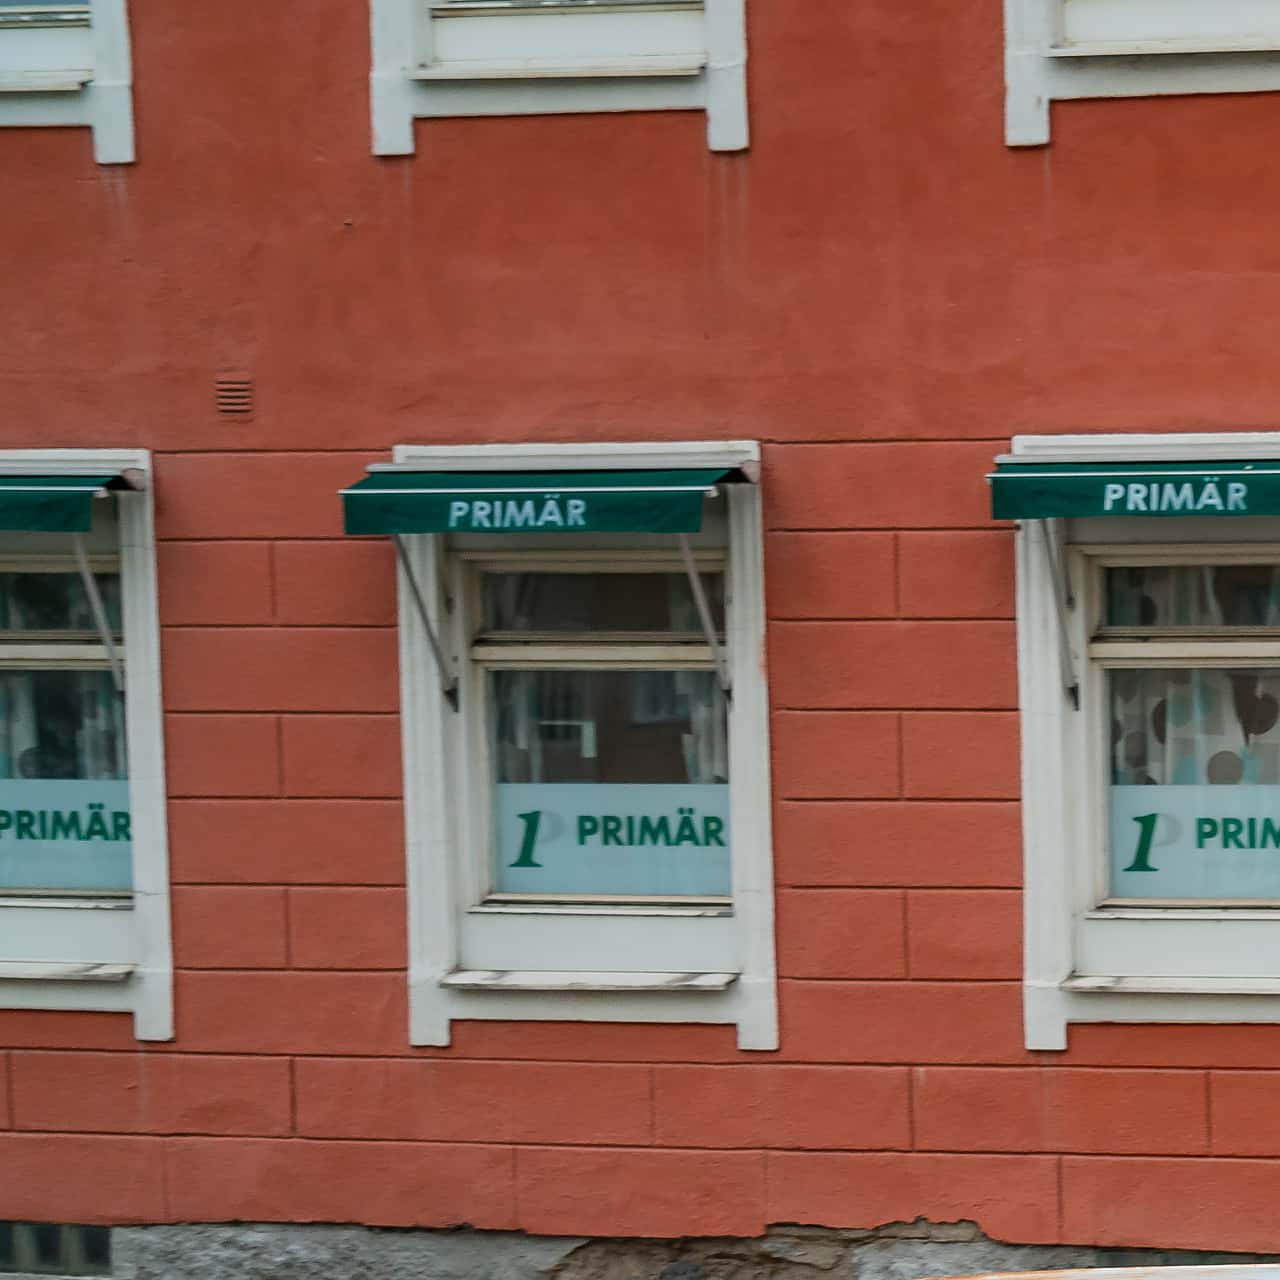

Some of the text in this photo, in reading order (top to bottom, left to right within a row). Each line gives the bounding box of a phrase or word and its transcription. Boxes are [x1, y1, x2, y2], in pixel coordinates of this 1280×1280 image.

[449, 494, 587, 528] PRIMÄR
[1103, 477, 1248, 511] PRIMÄR
[0, 802, 132, 842] PRIMÄR
[576, 807, 727, 848] PRIMÄR
